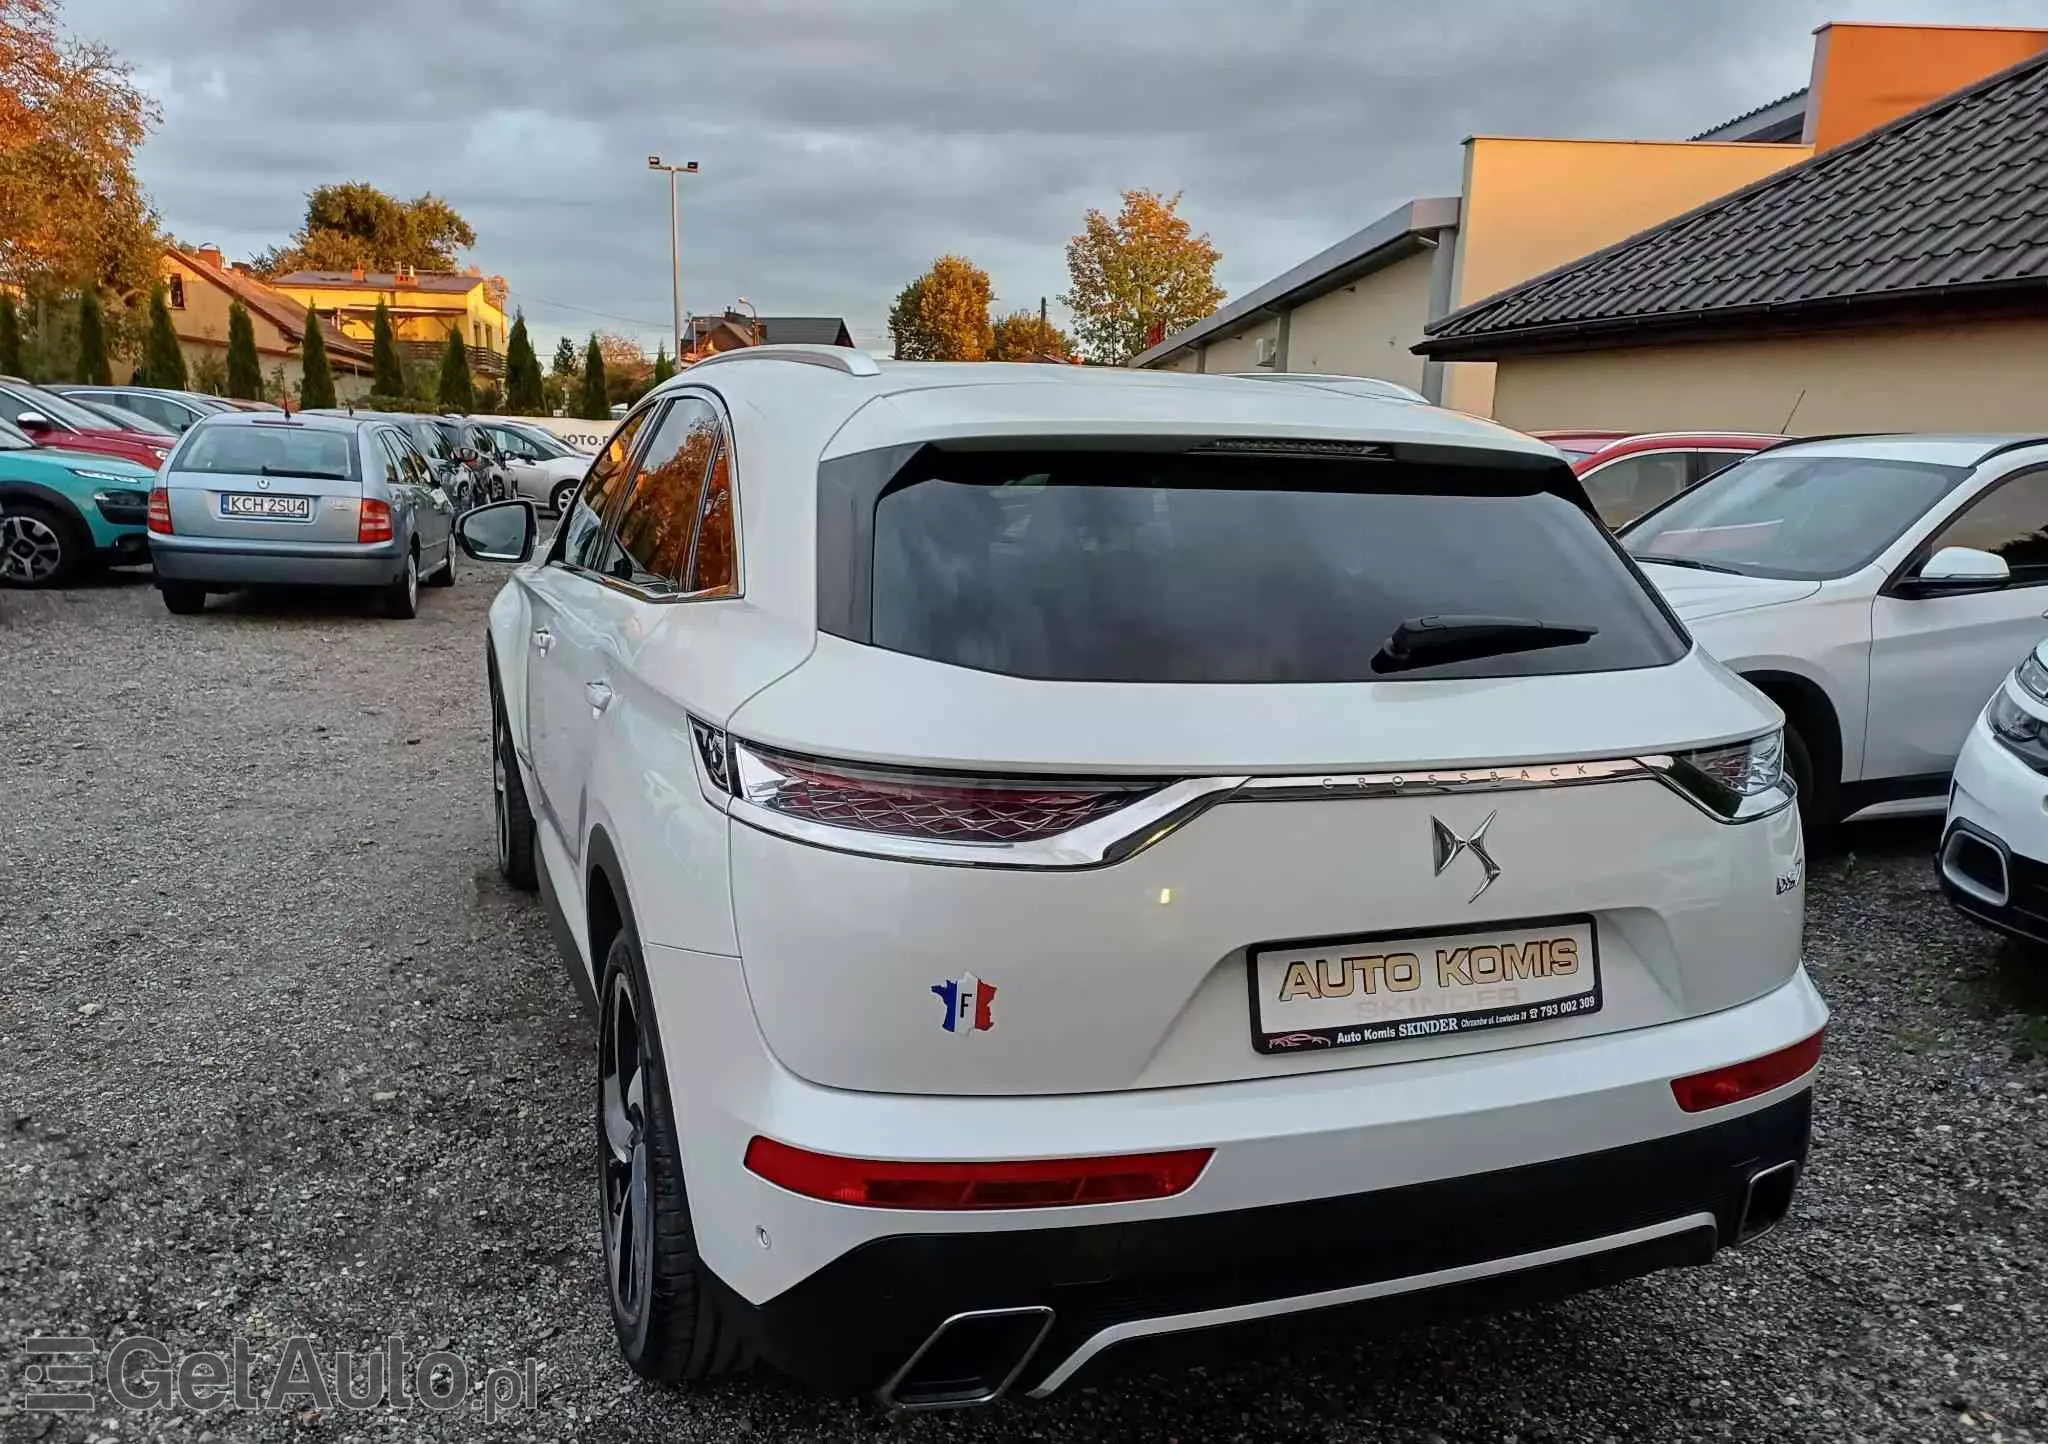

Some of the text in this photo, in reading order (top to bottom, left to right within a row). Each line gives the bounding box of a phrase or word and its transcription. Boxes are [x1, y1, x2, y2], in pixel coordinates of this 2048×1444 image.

[231, 496, 305, 514] KCH 2SU4
[1322, 764, 1587, 790] CROSSBACK
[1279, 937, 1579, 1002] AUTO KOMIS
[960, 993, 973, 1018] F
[1337, 1032, 1362, 1044] Auto
[1364, 1026, 1396, 1041] Komis
[1399, 1017, 1459, 1037] SKINDER
[1540, 1004, 1559, 1018] 793
[1561, 1001, 1578, 1014] 002
[1579, 995, 1596, 1009] 309
